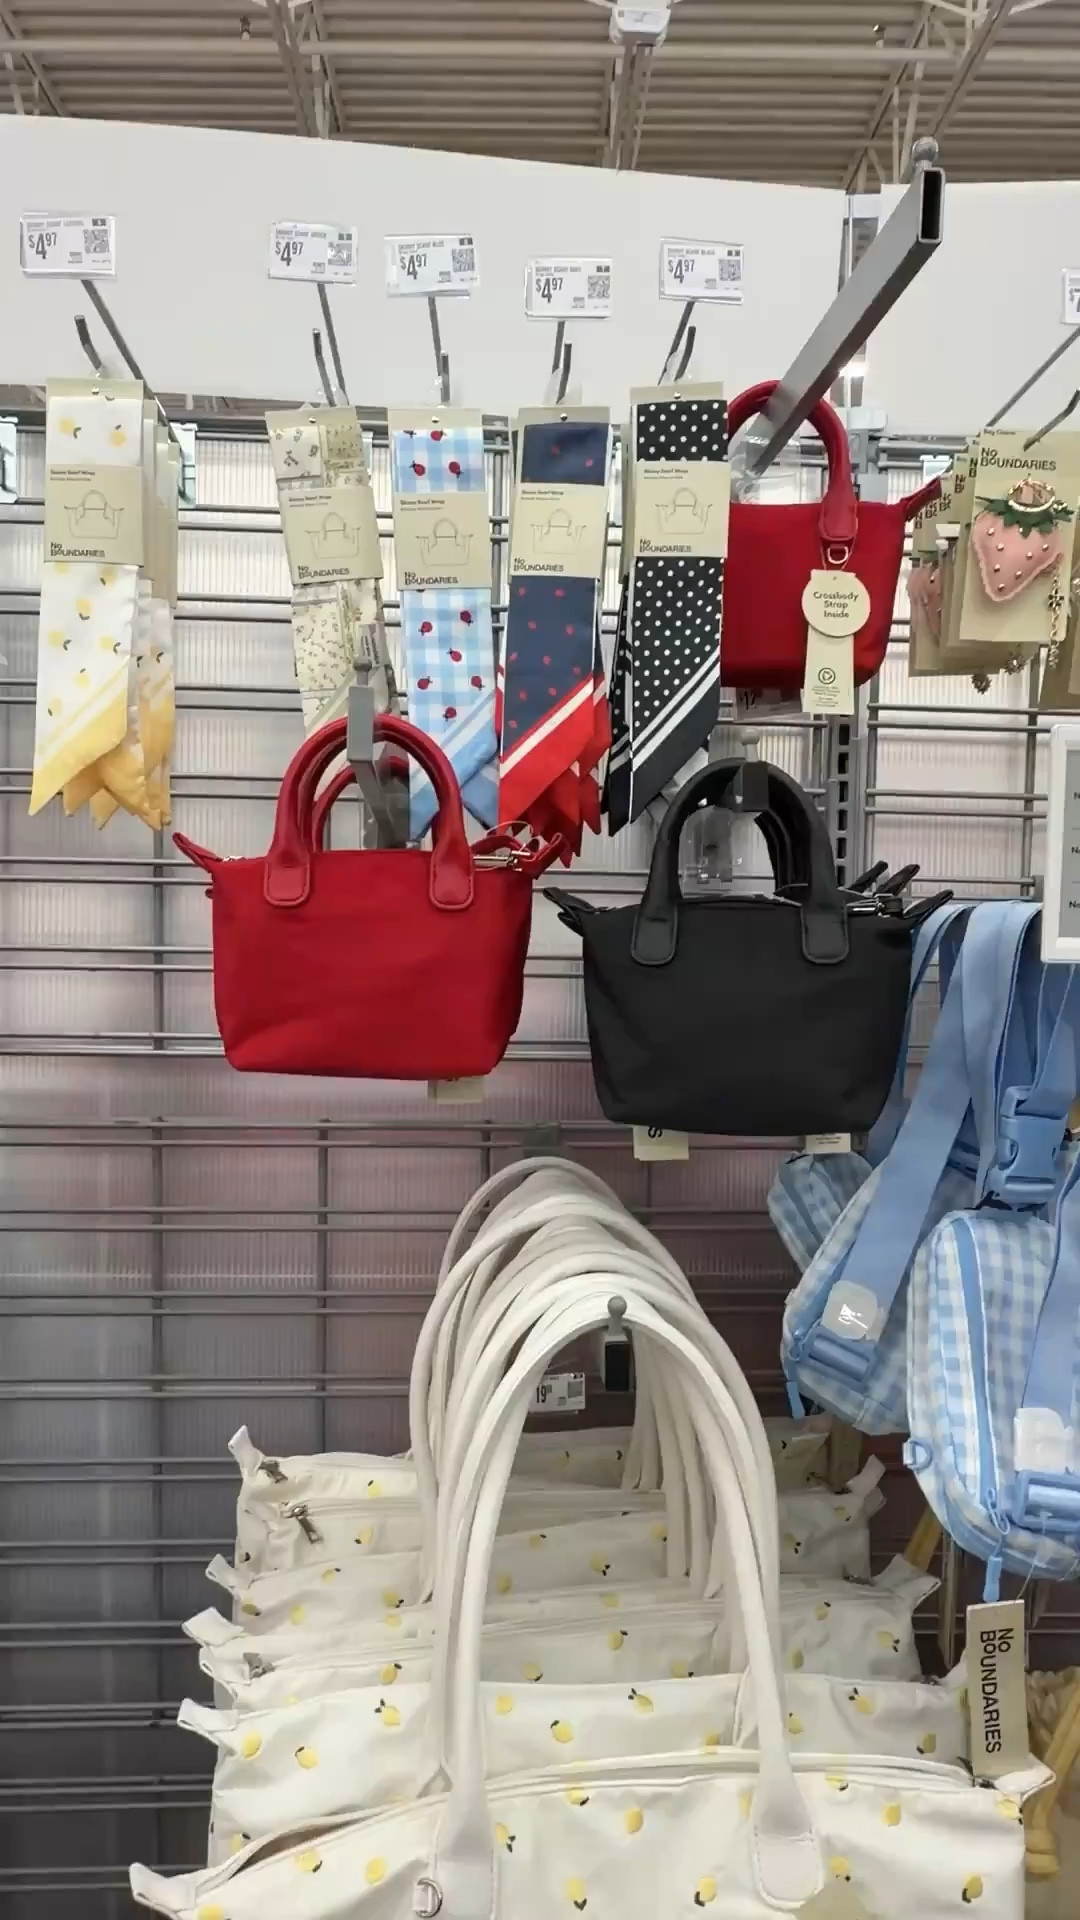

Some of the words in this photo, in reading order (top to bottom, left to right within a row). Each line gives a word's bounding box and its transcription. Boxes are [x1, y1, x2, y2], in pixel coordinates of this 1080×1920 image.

[981, 447, 998, 457] No
[980, 456, 1056, 471] BOUNDARIES
[813, 591, 859, 601] Crossbody
[824, 600, 848, 609] Strap
[823, 610, 849, 618] Inside
[998, 1627, 1014, 1653] NO
[980, 1629, 1002, 1754] BOUNDARIES
